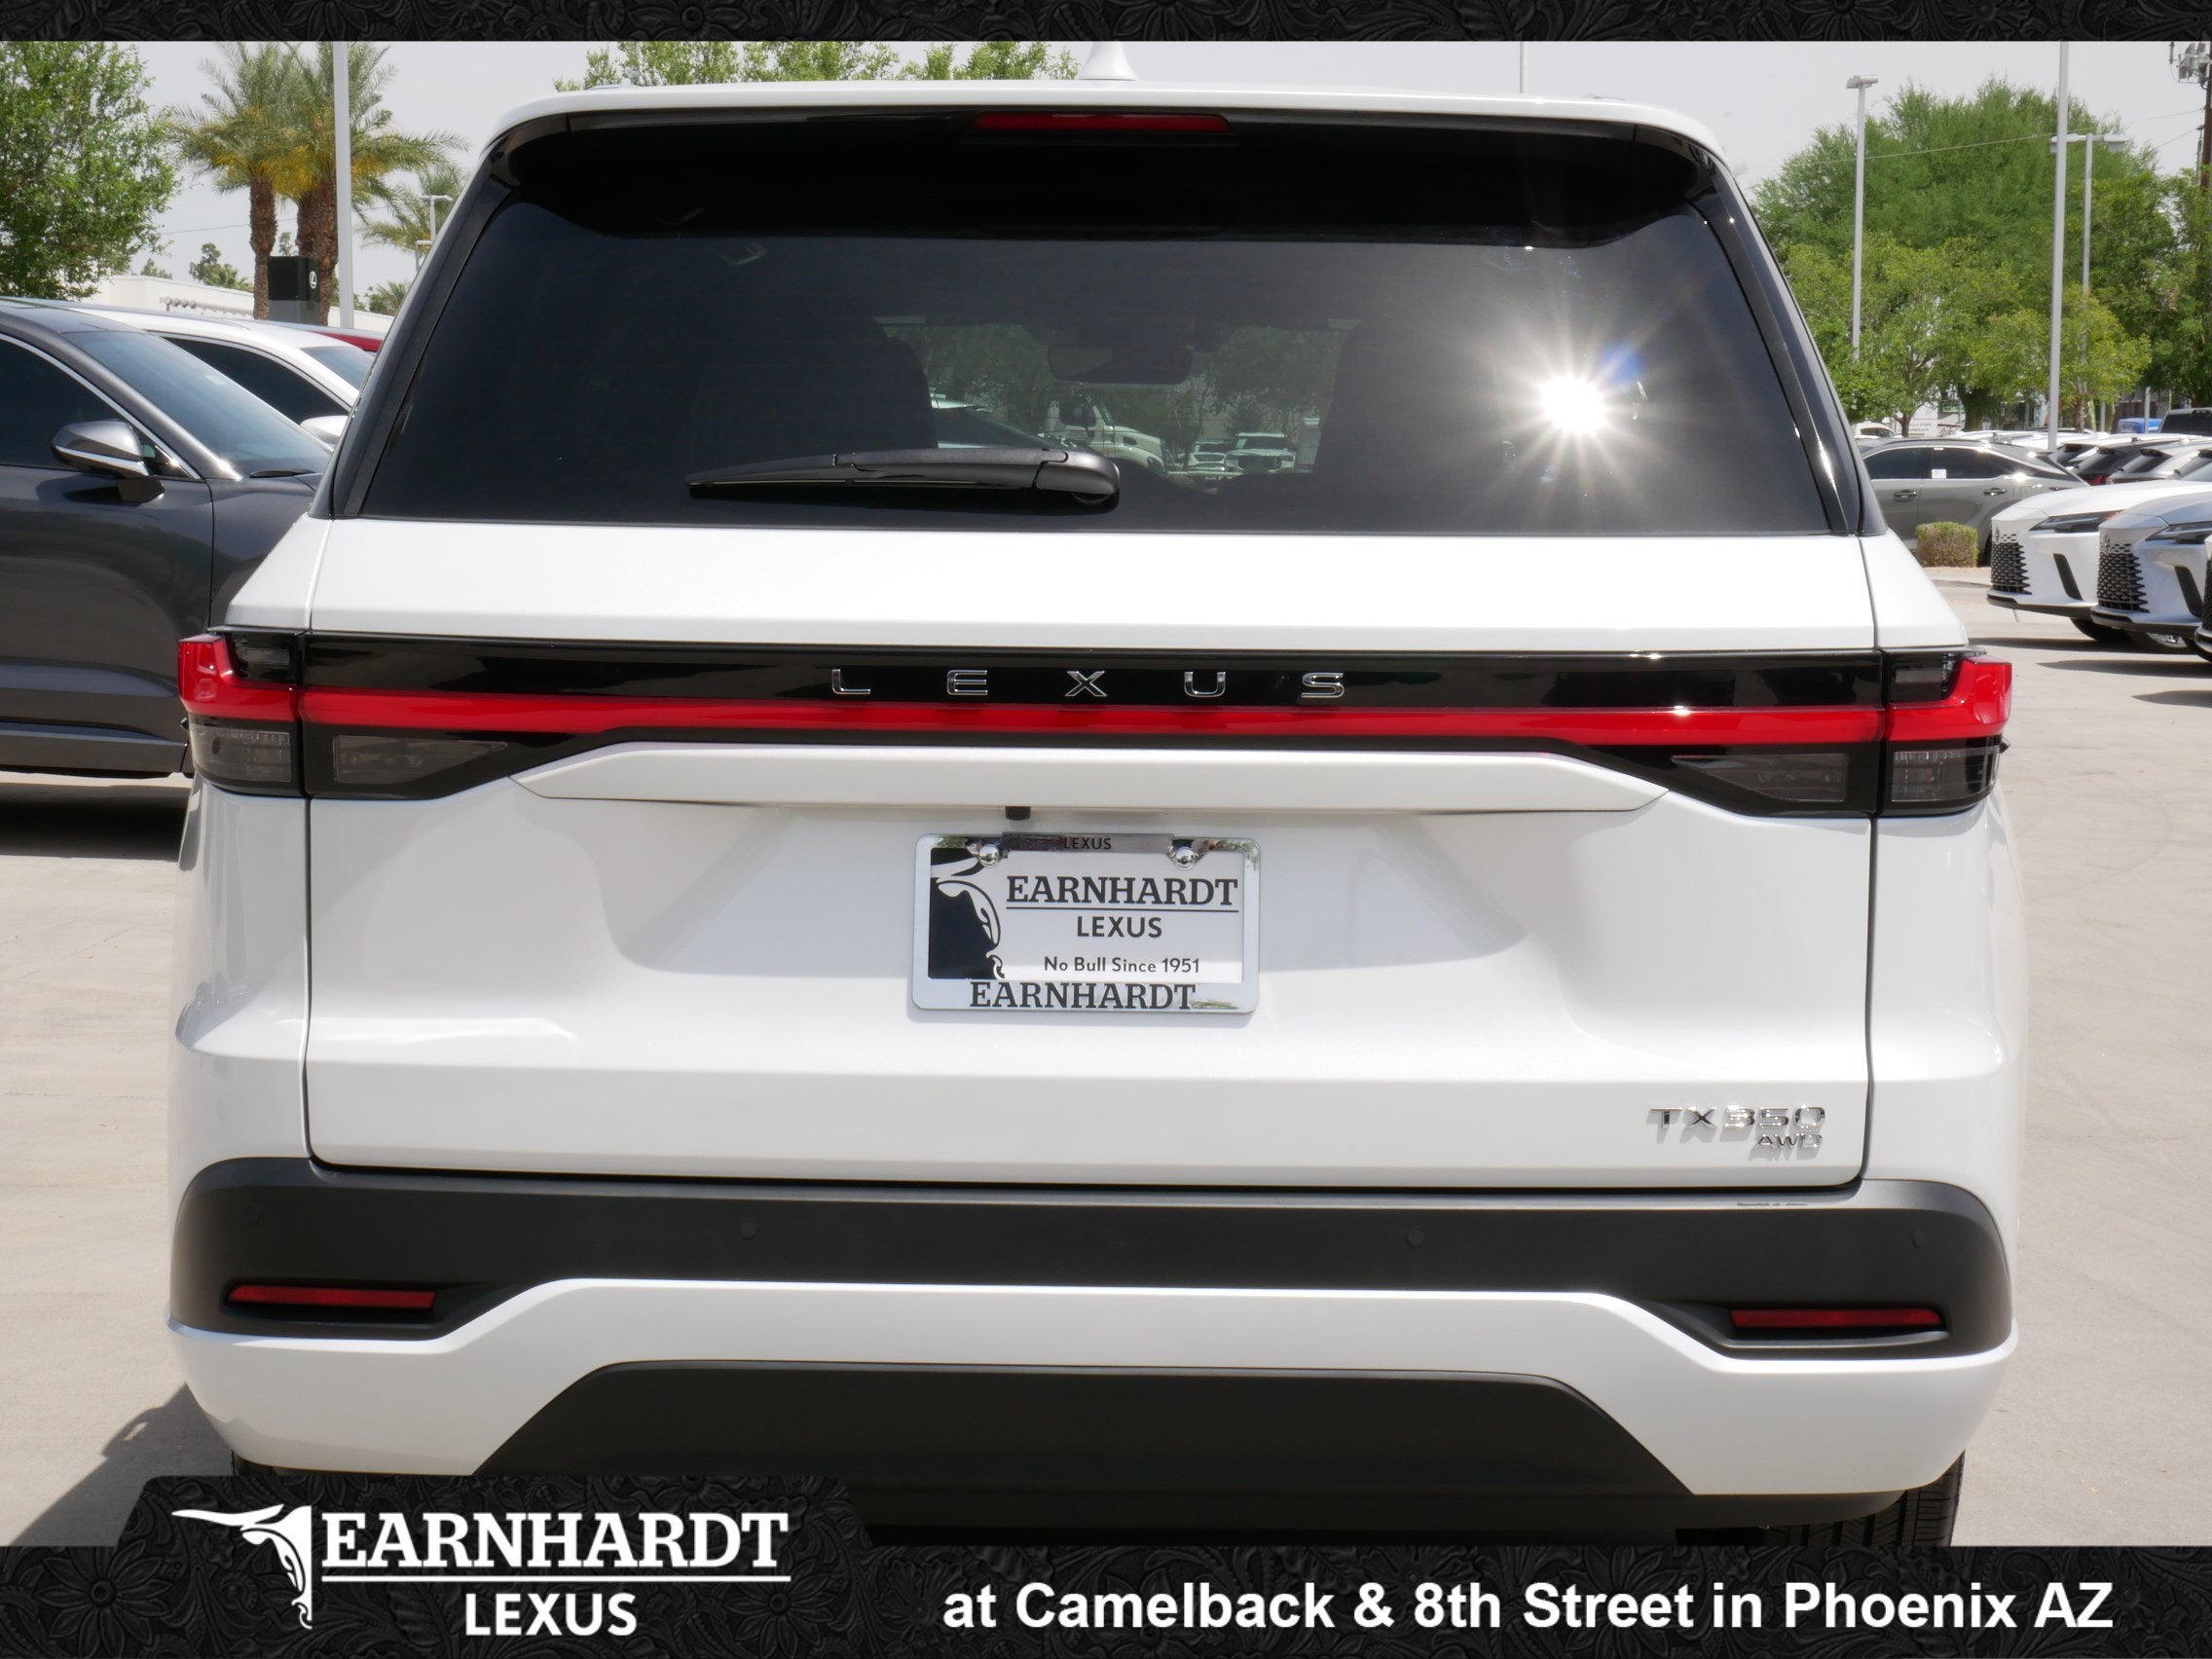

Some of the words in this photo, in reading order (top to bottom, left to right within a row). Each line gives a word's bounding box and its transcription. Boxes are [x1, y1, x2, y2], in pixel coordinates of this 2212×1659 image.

[831, 668, 1346, 699] LEXUS
[1063, 837, 1112, 850] LEXUS
[1006, 875, 1238, 906] EARNHARDT
[1077, 915, 1162, 939] LEXUS
[1044, 956, 1068, 972] No
[1074, 956, 1106, 973] Bull
[1112, 956, 1157, 973] Since
[1161, 958, 1199, 974] 1951
[970, 981, 1197, 1011] EARNHARDT
[1754, 1133, 1824, 1150] AWD
